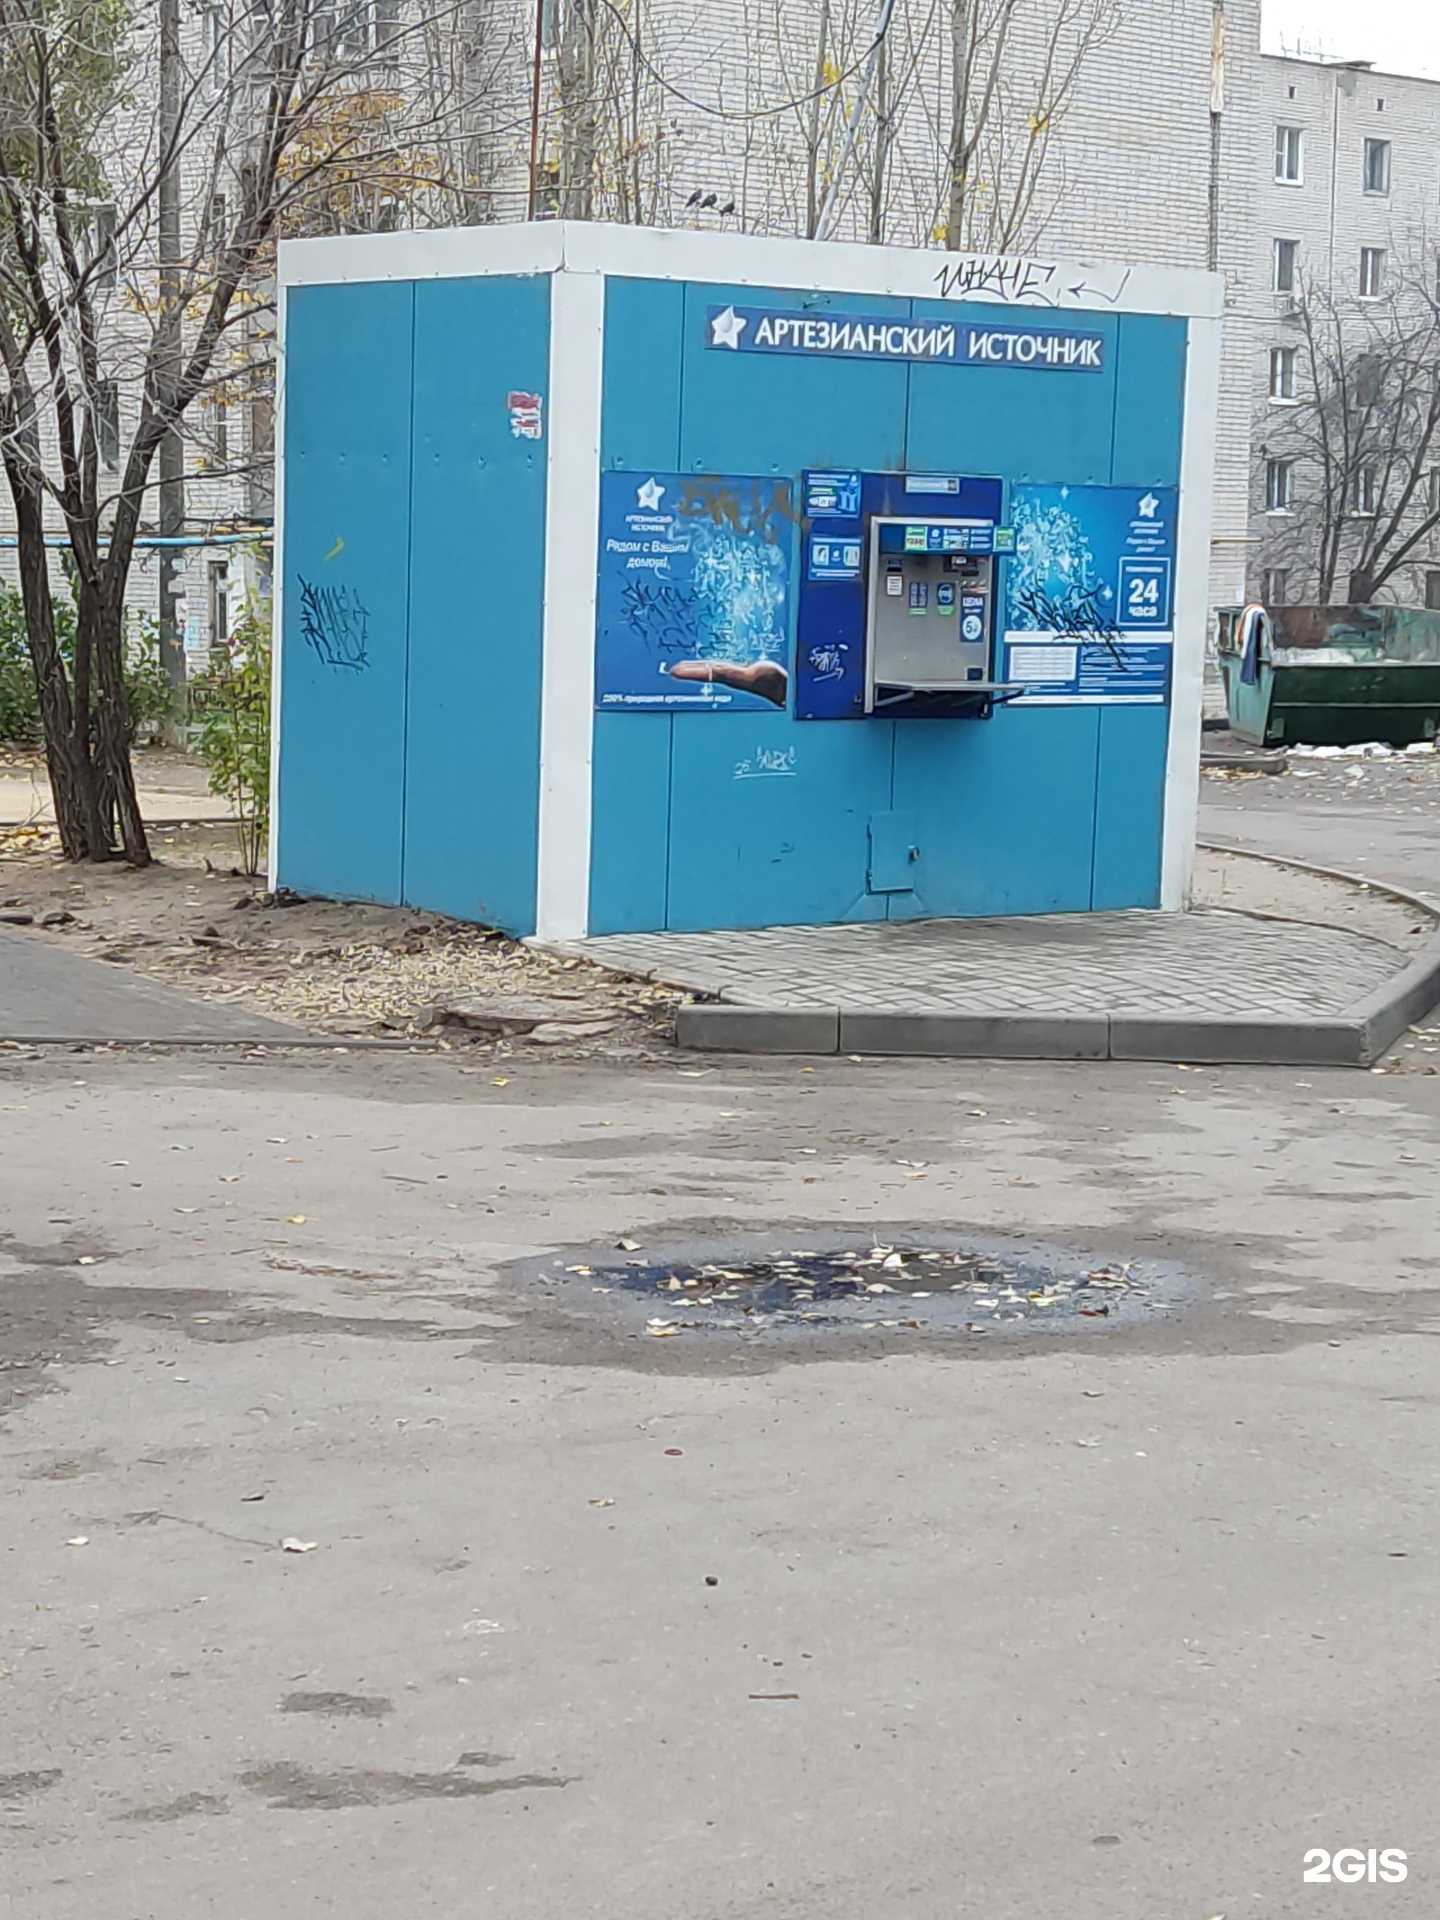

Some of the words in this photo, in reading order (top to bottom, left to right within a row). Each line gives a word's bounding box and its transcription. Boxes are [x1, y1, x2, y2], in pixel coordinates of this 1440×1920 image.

[753, 315, 956, 358] АРТЕЗИАНСКИЙ
[967, 328, 1102, 367] ИСТОЧНИК
[1128, 578, 1159, 604] 24
